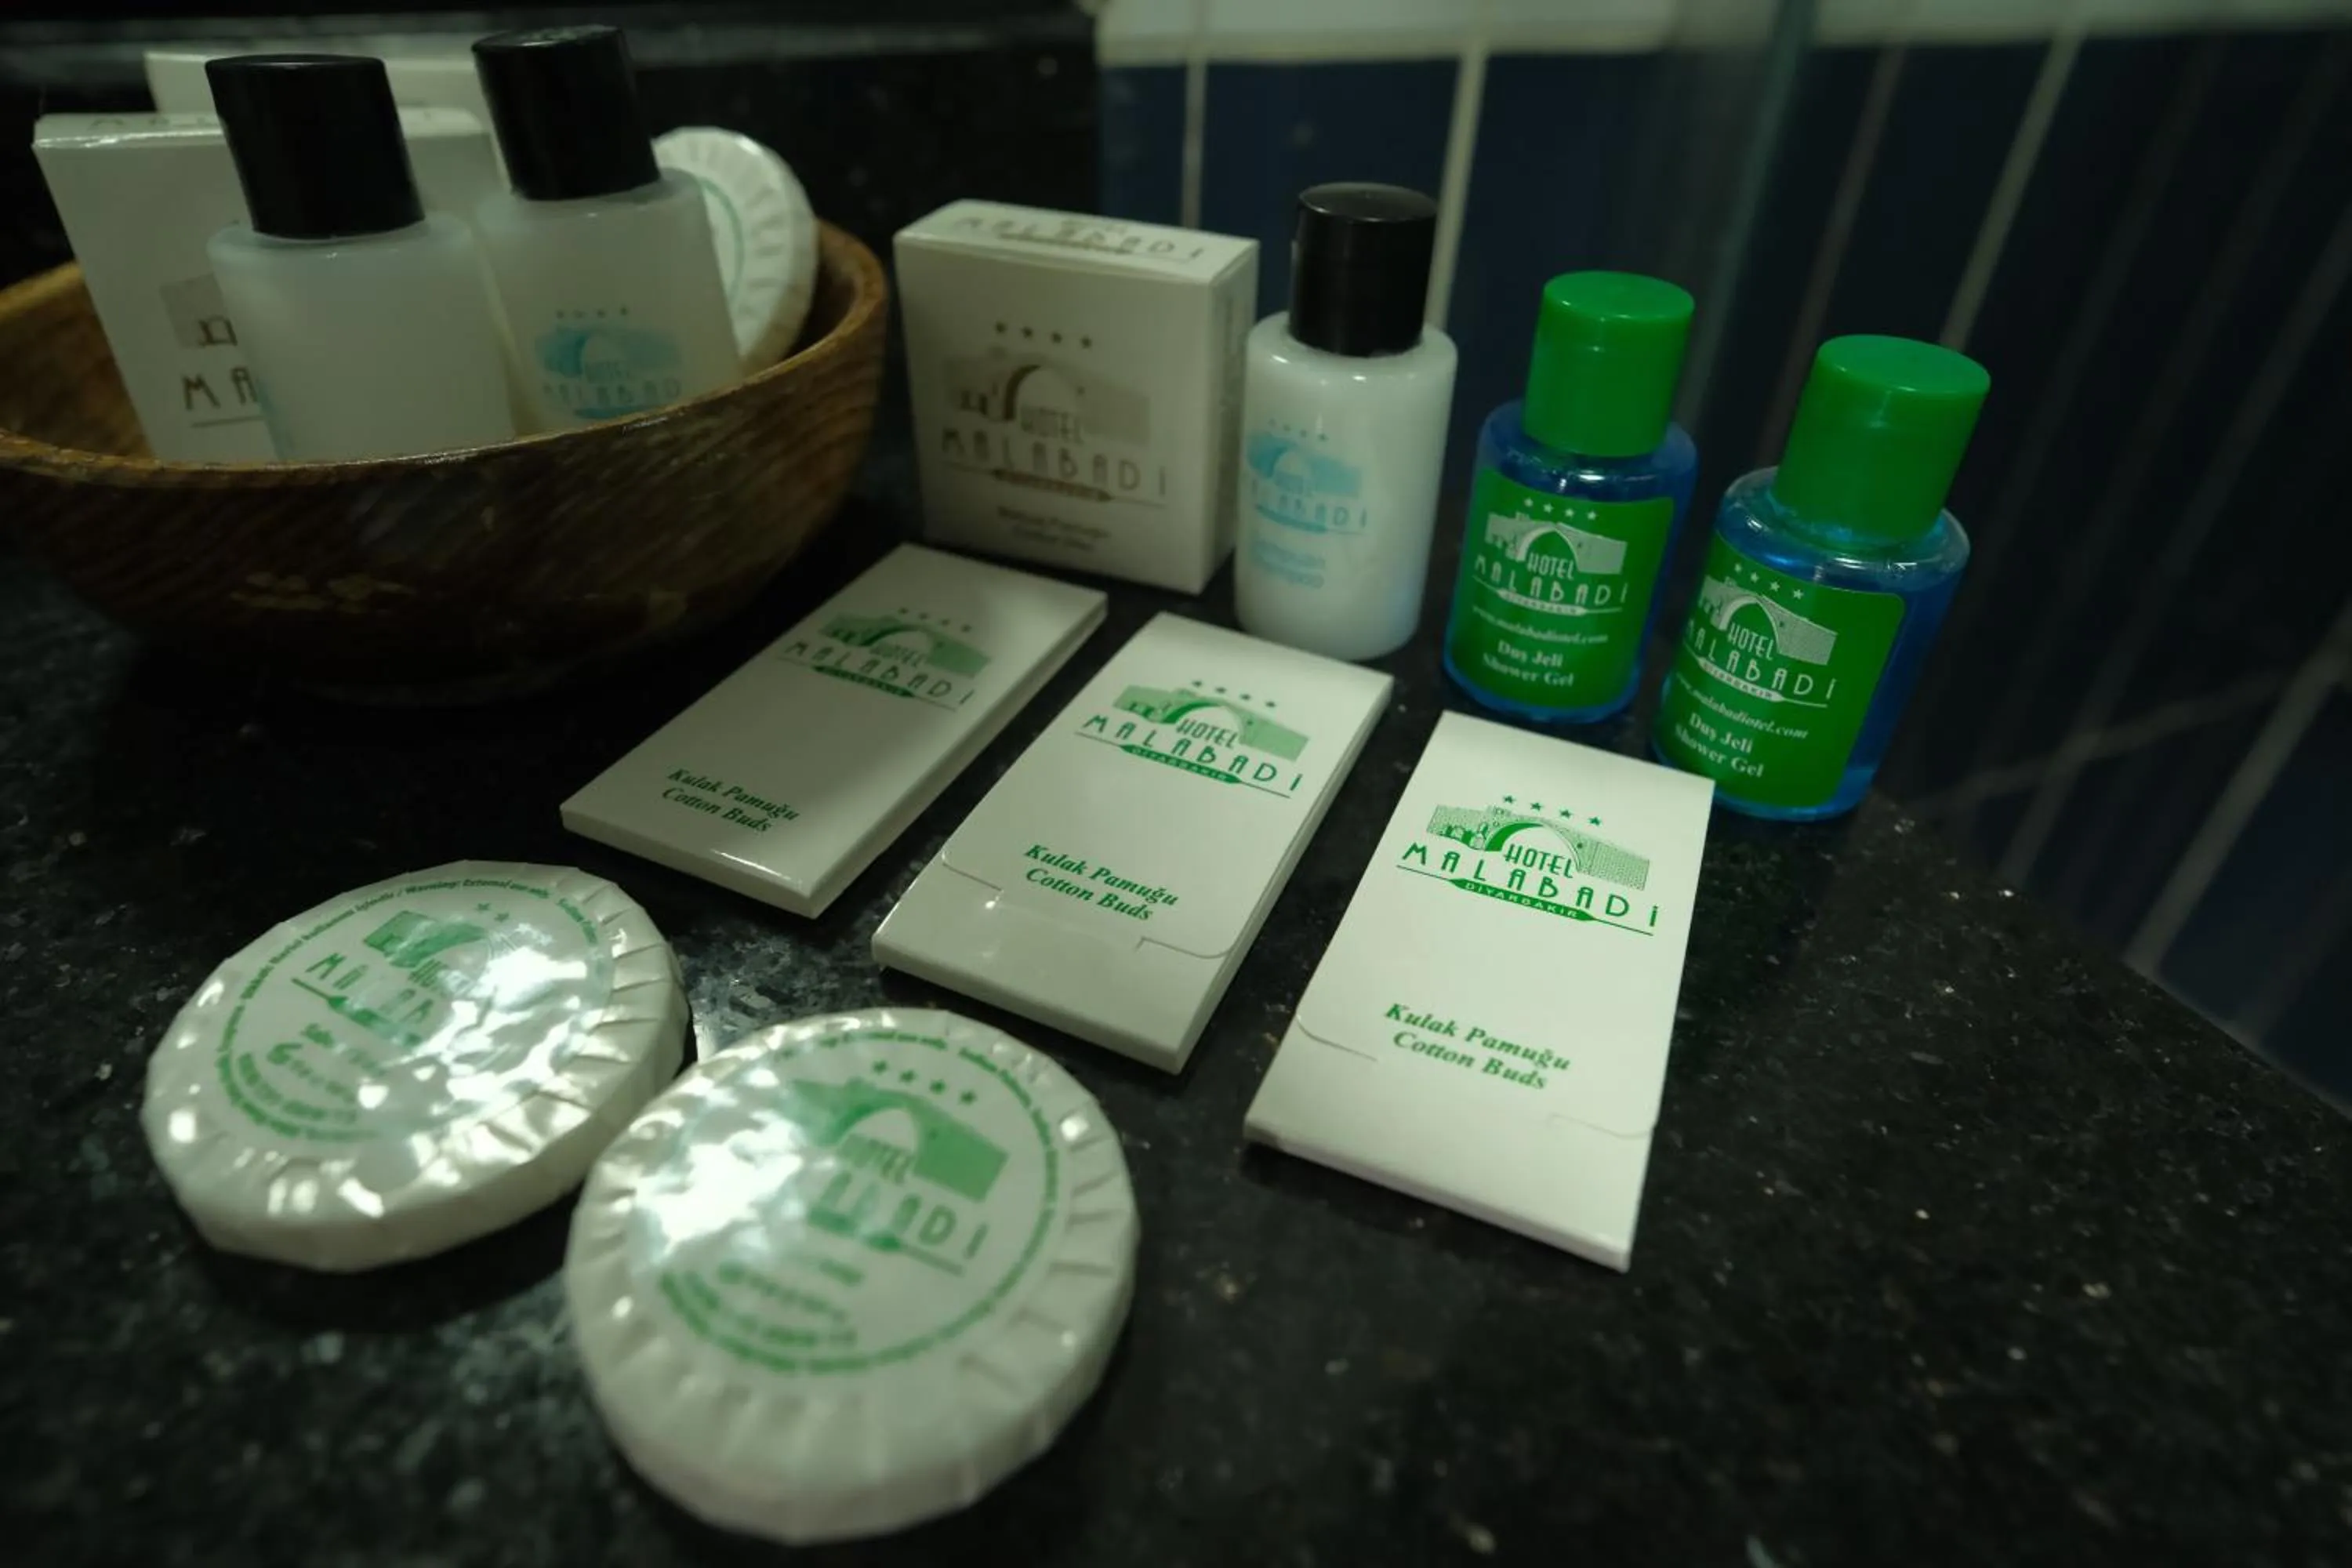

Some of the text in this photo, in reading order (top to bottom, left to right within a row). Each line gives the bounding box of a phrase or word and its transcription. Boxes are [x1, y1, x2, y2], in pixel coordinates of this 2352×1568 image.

[1526, 552, 1575, 581] HOTEL
[1532, 649, 1564, 669] Jeli
[1726, 622, 1774, 661] HOTEL
[1543, 671, 1574, 688] Gel
[1177, 717, 1239, 750] HOTEL
[1675, 723, 1765, 778] Shower Gel
[1719, 731, 1753, 754] Jeli
[662, 786, 772, 832] Cotton Buds
[668, 768, 800, 821] Kulak Pamuğu
[1016, 844, 1179, 906] Kulak Pamuğu
[1503, 843, 1573, 879] HOTEL
[1025, 867, 1154, 921] Cotton Buds
[1384, 1003, 1571, 1070] Kulak Pamuğu
[1392, 1030, 1548, 1090] Cotton Buds
